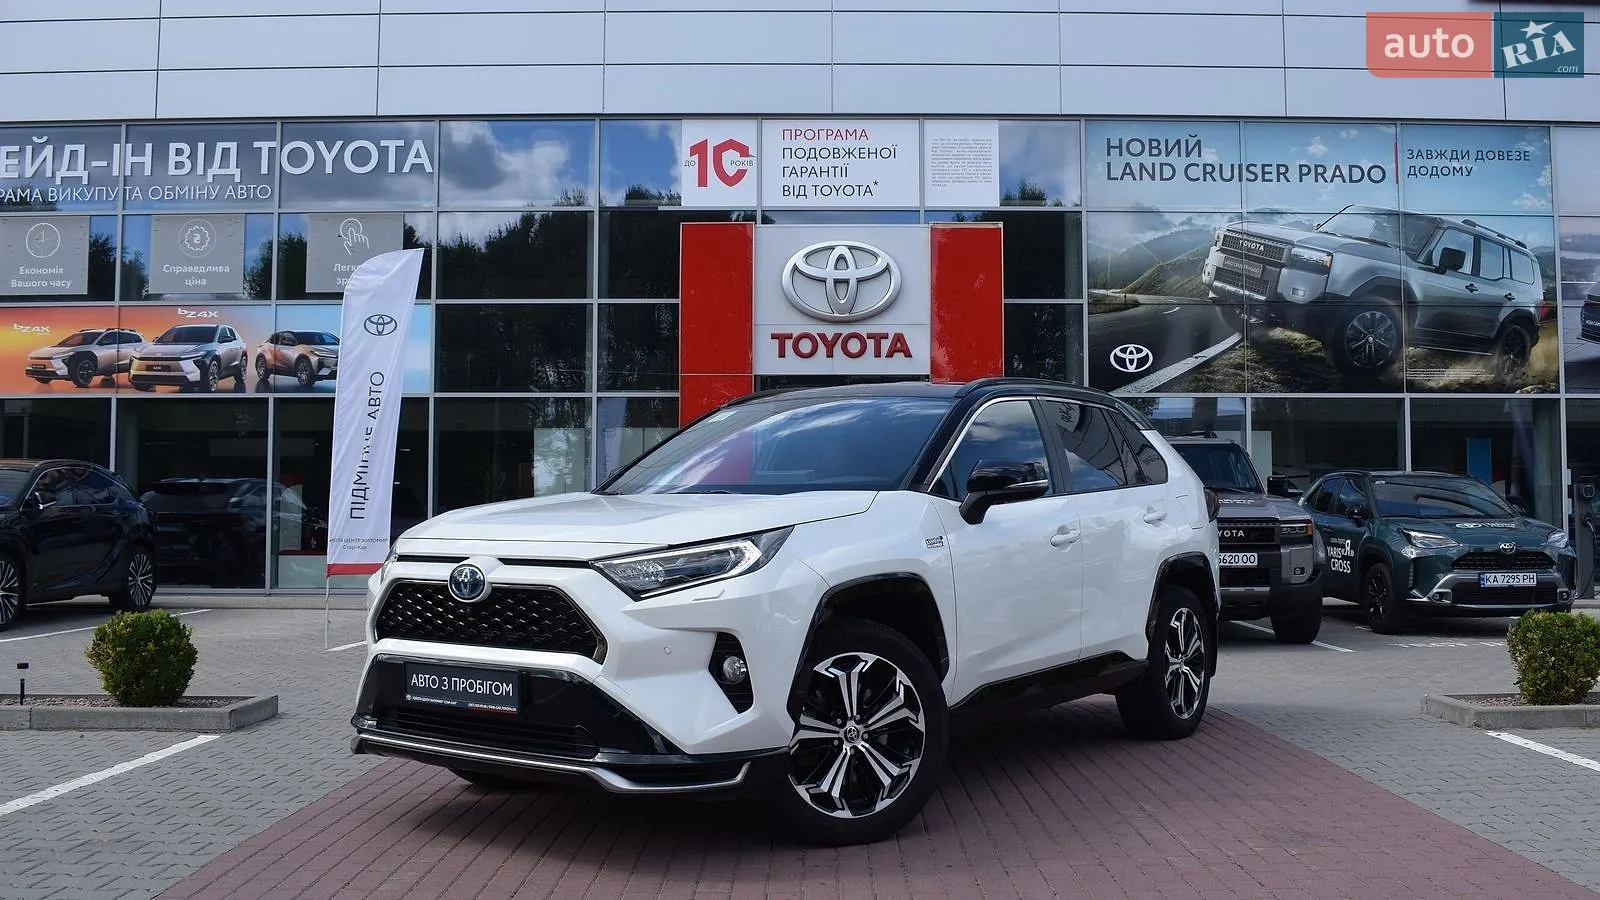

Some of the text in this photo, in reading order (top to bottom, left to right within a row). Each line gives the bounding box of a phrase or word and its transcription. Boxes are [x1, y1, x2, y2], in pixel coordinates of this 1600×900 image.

[782, 128, 869, 141] ПРОГРАМА
[782, 144, 898, 161] ПОДОВЖЕНОЇ
[1105, 133, 1203, 158] НОВИЙ
[167, 141, 242, 183] ВІД
[253, 139, 434, 176] TOYOTA
[1407, 148, 1531, 163] ЗАВЖДИ ДОВЕЗЕ
[684, 160, 696, 168] ДО
[782, 165, 849, 178] ГАРАНТІЇ
[1105, 162, 1387, 185] LAND CRUISER PRADO
[1407, 165, 1474, 179] ДОДОМУ
[48, 186, 118, 202] ВИКУПУ
[124, 186, 143, 201] ТА
[149, 184, 219, 200] ОБМІНУ
[224, 184, 272, 200] АВТО
[782, 184, 808, 199] ВІД
[1239, 239, 1265, 252] TOYOTA
[19, 265, 64, 275] Економія
[163, 264, 230, 275] Справедлива
[333, 263, 360, 272] Легк
[11, 279, 72, 289] Вашого часу
[185, 276, 207, 287] ціна
[770, 332, 913, 359] TOYOTA
[367, 371, 385, 421] АВТО
[1331, 558, 1351, 573] CROSS
[1485, 573, 1536, 584] KA 7295 PH
[411, 673, 439, 689] АВТО
[451, 677, 513, 697] ПРОБІГОМ
